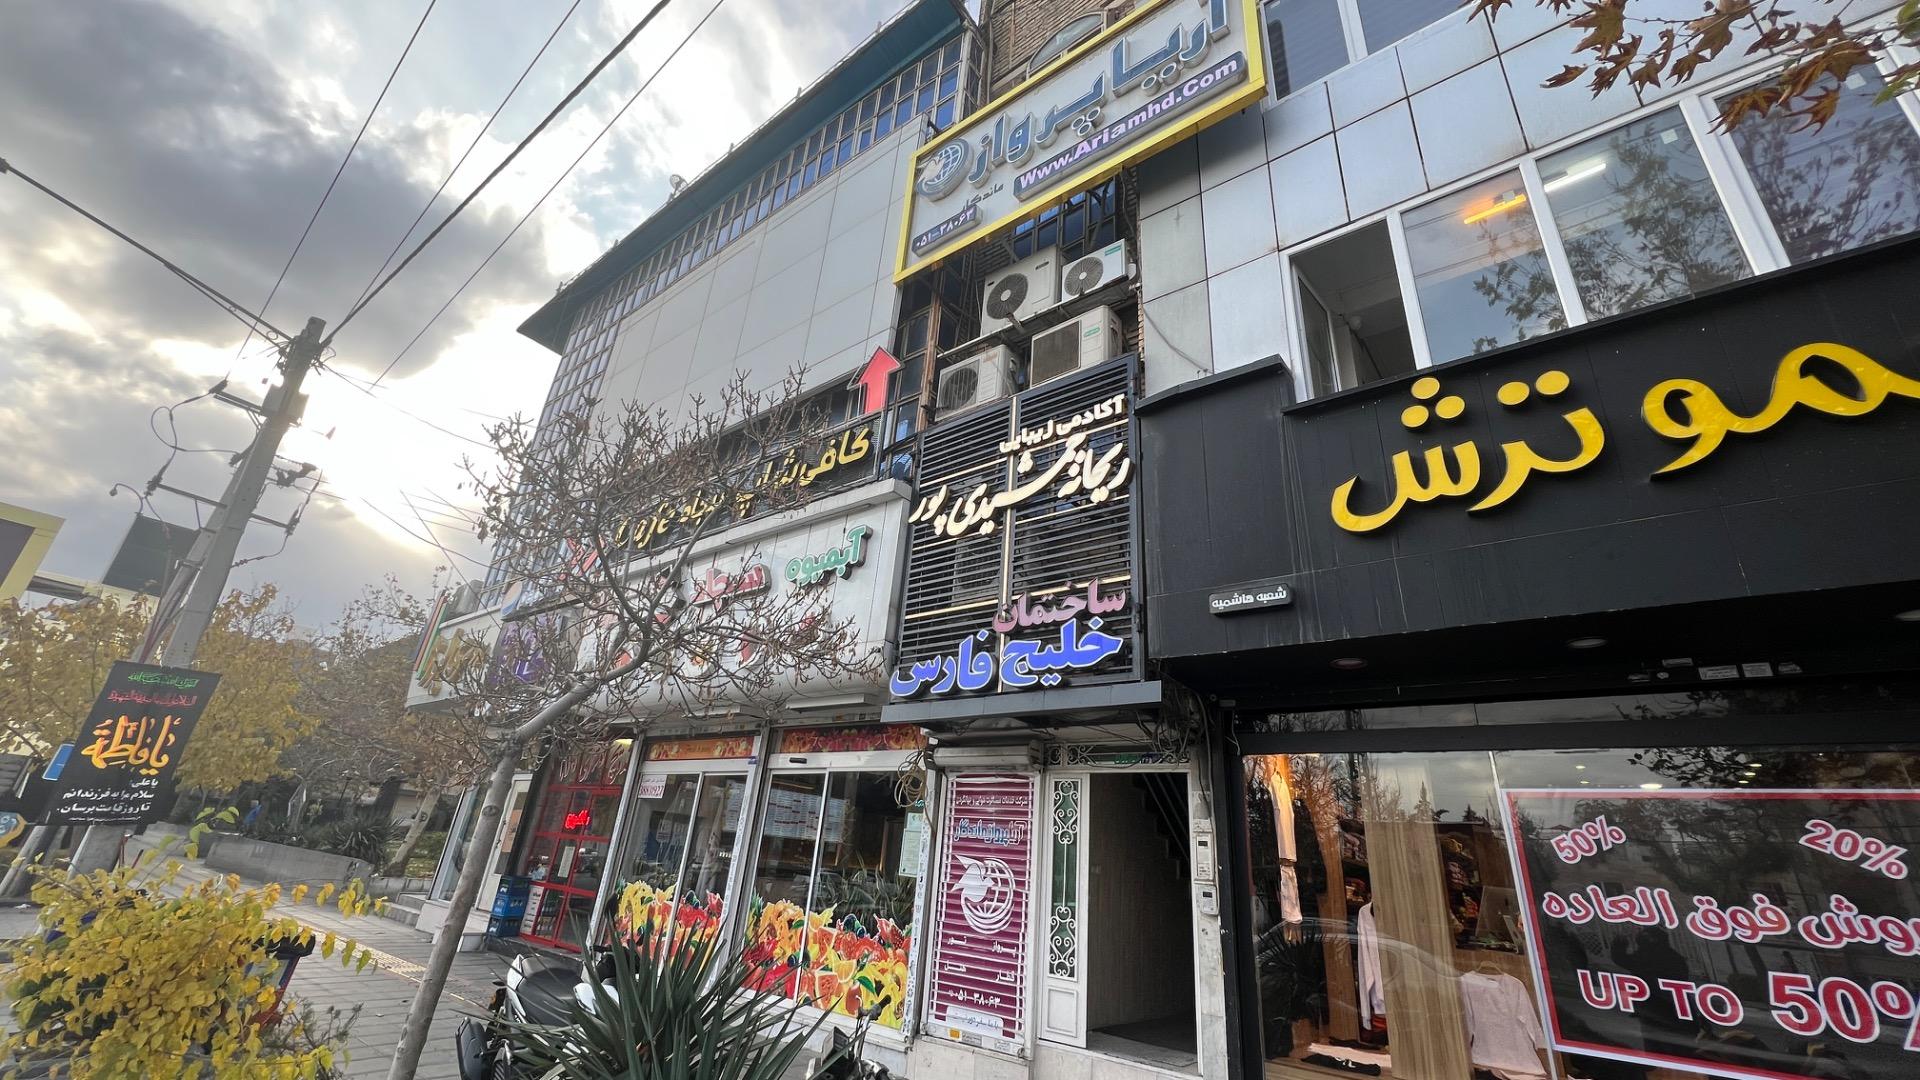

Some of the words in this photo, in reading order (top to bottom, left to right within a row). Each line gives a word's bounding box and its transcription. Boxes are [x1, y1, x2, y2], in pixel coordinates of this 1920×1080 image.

[967, 70, 1104, 186] پرواز
[1019, 58, 1239, 190] Www.Ariamhd.Com
[1056, 393, 1125, 435] آکادمی
[1058, 443, 1131, 504] ریحانه
[1331, 370, 1606, 534] ترش
[908, 485, 948, 536] پور
[785, 525, 868, 587] آبمیوه
[992, 577, 1127, 632] ساختمان
[1212, 593, 1254, 609] هاشمیه
[1256, 586, 1287, 603] شعبه
[889, 629, 993, 696] فارس
[999, 616, 1124, 687] خلیج
[121, 803, 139, 814] روز
[130, 790, 154, 800] سلام
[140, 802, 151, 811] تا
[151, 778, 159, 788] یا
[1550, 814, 1626, 864] 50%
[1799, 820, 1909, 879] 20%
[1543, 885, 1679, 929] العاده
[1686, 893, 1791, 944] فوق
[991, 940, 1017, 957] پرواز
[1577, 968, 1651, 1013] UP
[1658, 977, 1744, 1027] TO
